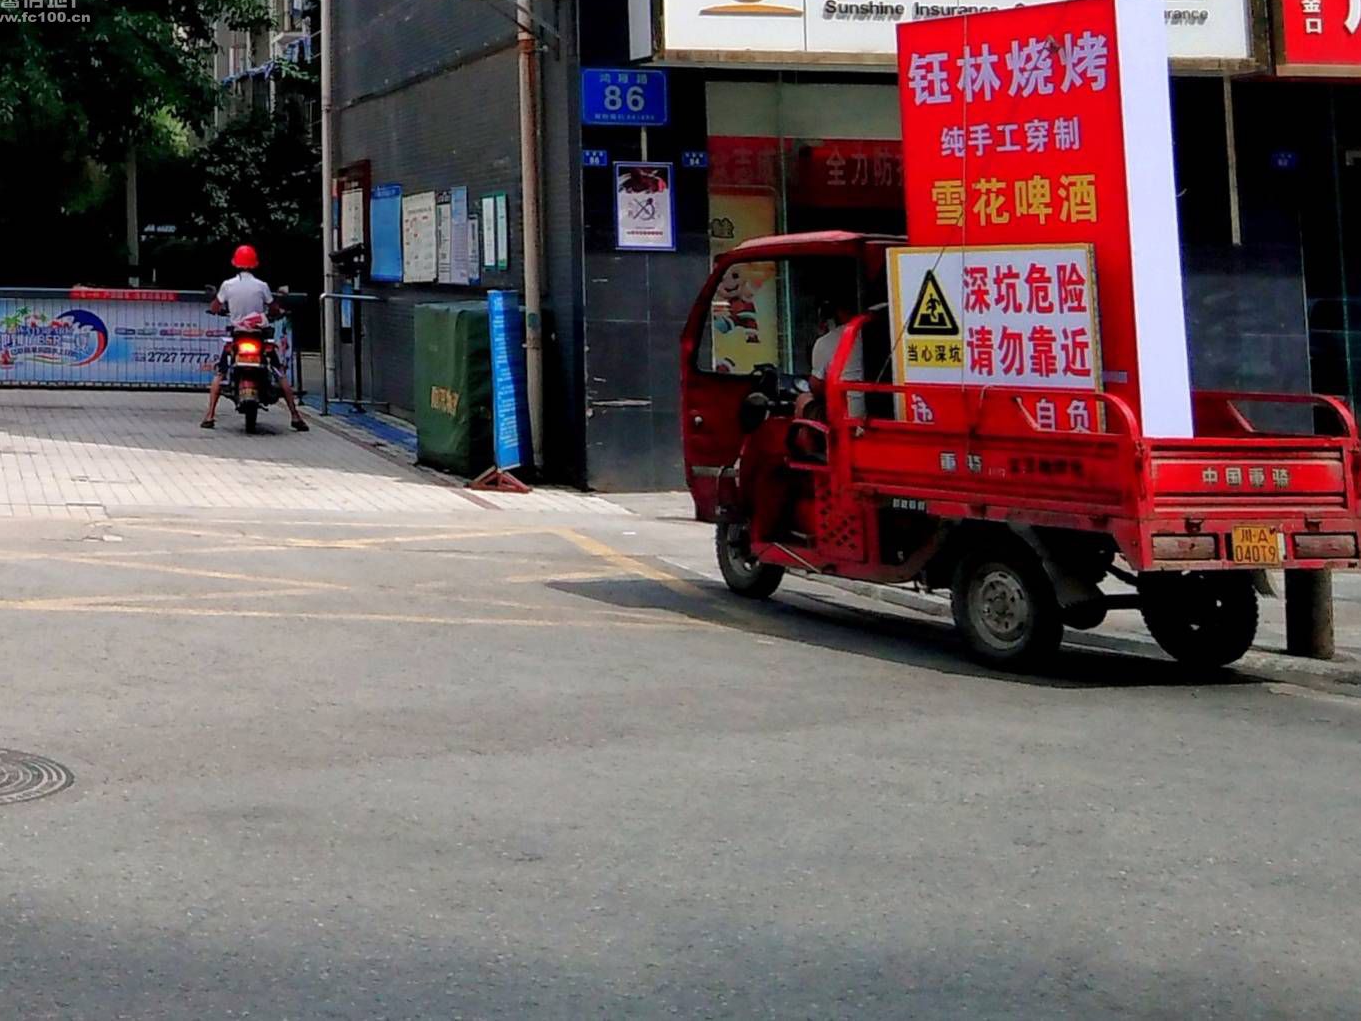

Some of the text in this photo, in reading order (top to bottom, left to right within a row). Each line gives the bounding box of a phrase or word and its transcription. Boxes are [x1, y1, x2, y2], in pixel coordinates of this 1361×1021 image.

[825, 0, 905, 16] Sunshine
[908, 31, 1108, 106] 钰林烧烤
[604, 86, 645, 112] 86
[940, 117, 1080, 158] 纯手工穿制
[932, 174, 1098, 227] 雪花啤酒
[962, 262, 1088, 315] 深坑危险
[147, 351, 177, 364] 2727
[907, 344, 962, 364] 当心深坑
[967, 325, 1092, 378] 请勿靠近
